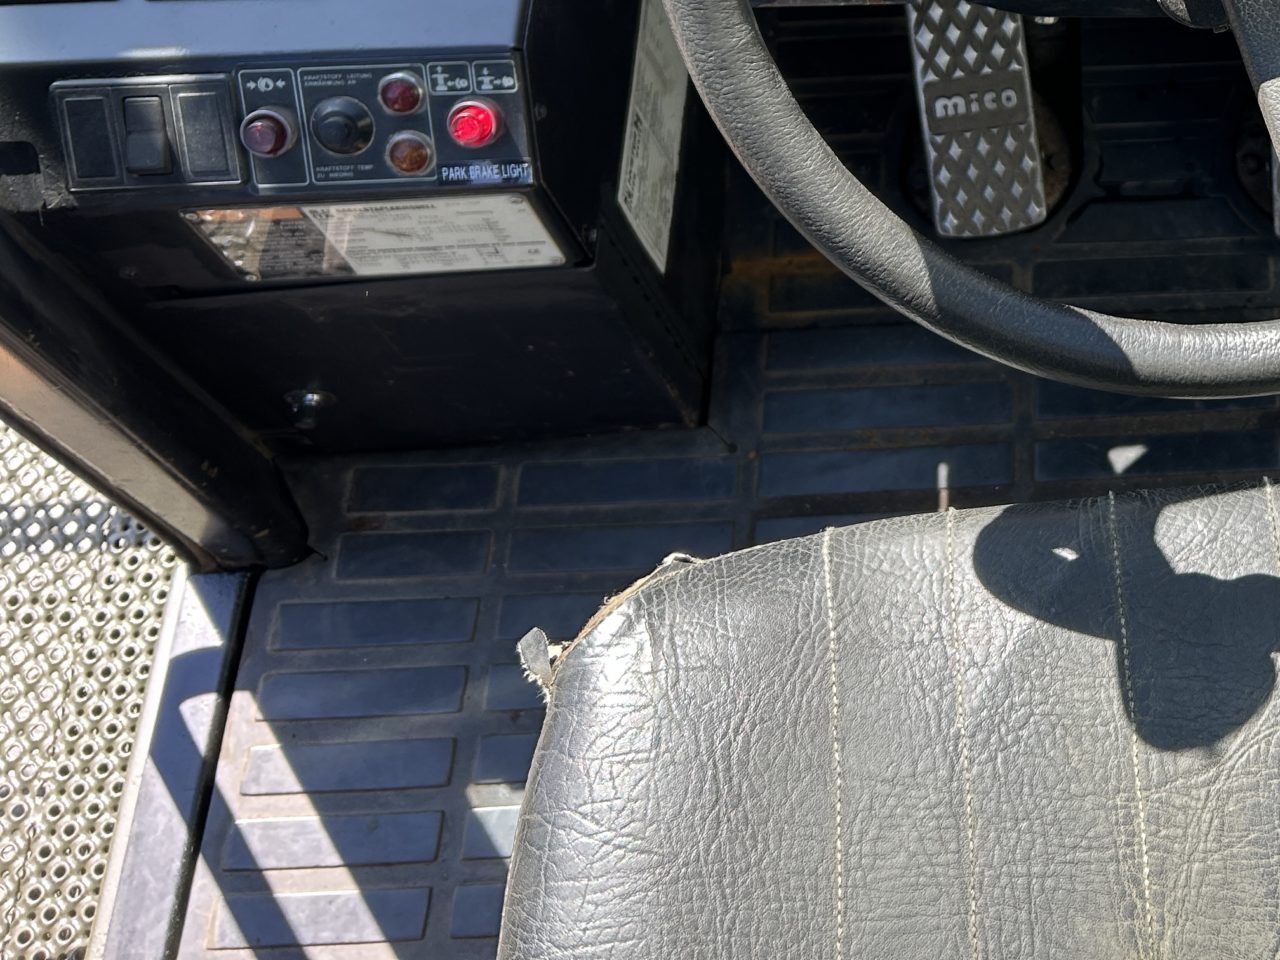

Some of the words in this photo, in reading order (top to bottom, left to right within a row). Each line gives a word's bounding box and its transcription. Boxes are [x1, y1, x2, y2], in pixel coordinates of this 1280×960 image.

[935, 87, 1019, 119] mico
[441, 166, 468, 181] PARK
[469, 164, 500, 179] BRAKE
[501, 163, 528, 178] LIGHT
